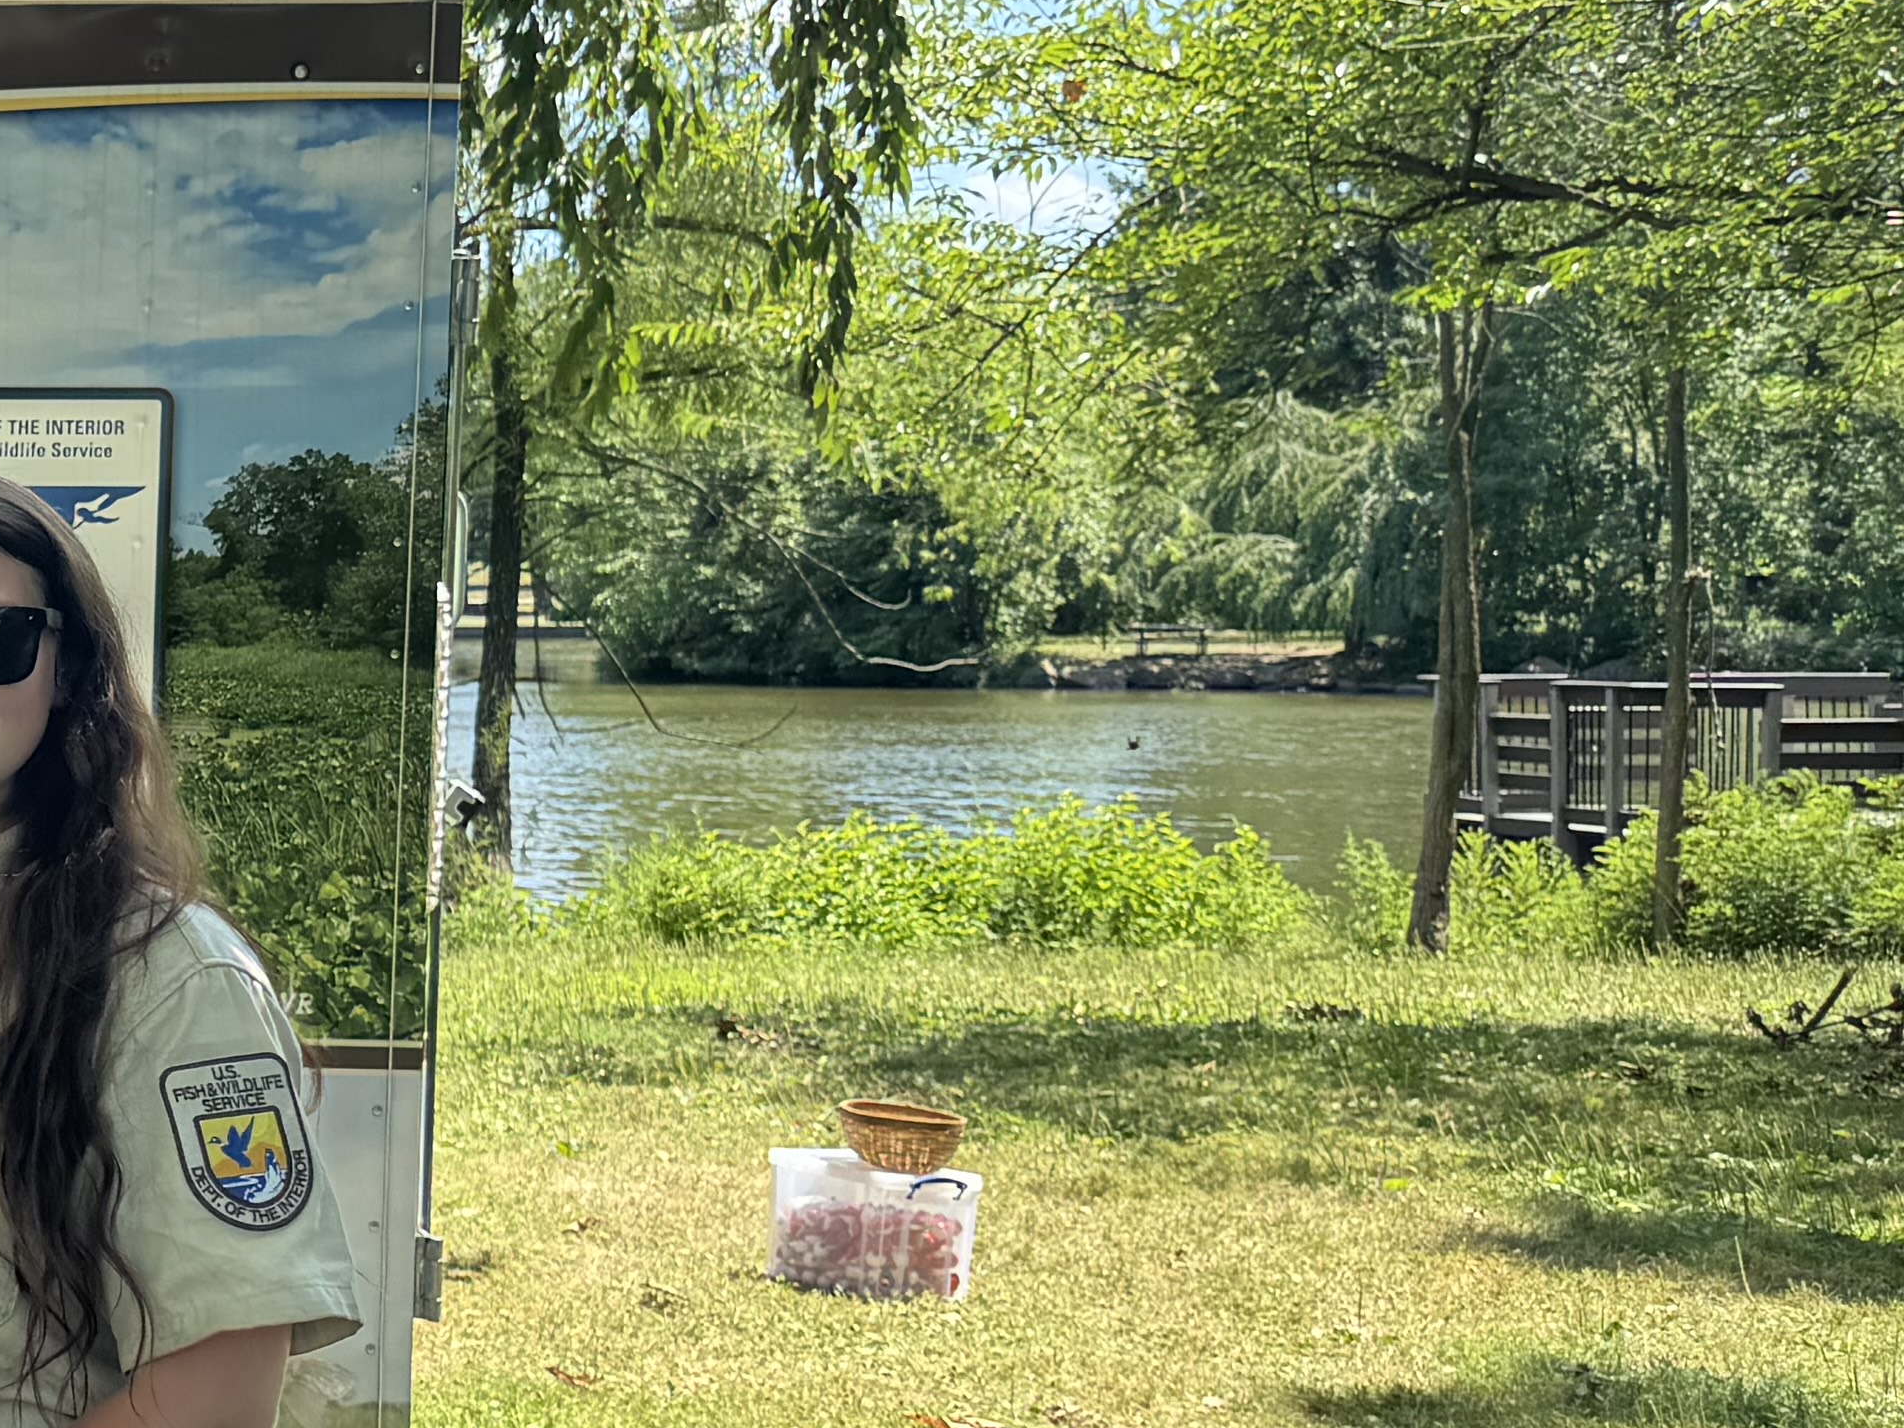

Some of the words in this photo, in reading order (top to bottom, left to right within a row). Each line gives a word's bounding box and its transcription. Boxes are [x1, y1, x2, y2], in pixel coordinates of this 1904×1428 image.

[8, 419, 40, 435] THE
[45, 419, 126, 436] INTERIOR
[51, 442, 113, 459] Service
[211, 1065, 241, 1081] U.S.
[172, 1085, 207, 1103] FISH
[206, 1083, 218, 1097] &
[216, 1074, 285, 1096] WILDLIFE
[202, 1092, 267, 1113] SERVICE
[191, 1165, 223, 1208] DEPT.
[224, 1201, 246, 1219] OF
[250, 1206, 282, 1223] THE
[279, 1149, 309, 1216] INTERIOR
